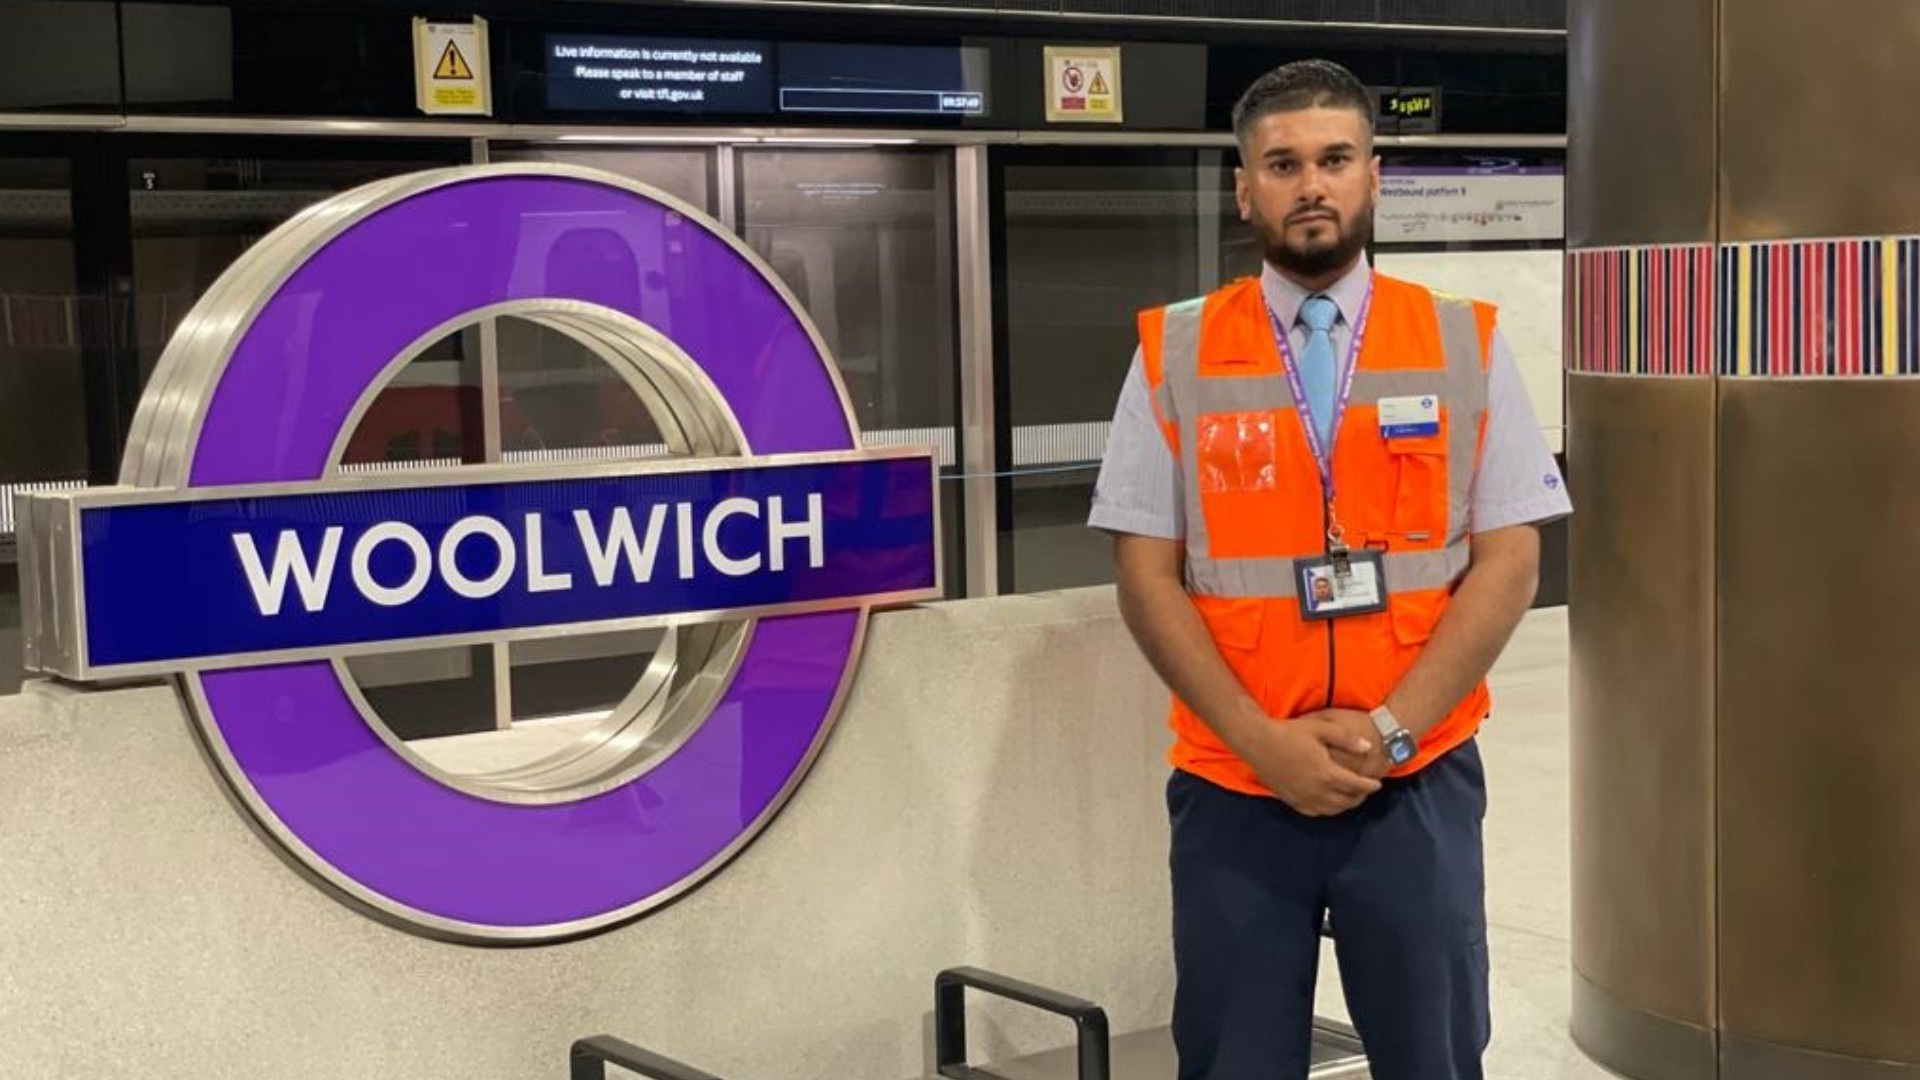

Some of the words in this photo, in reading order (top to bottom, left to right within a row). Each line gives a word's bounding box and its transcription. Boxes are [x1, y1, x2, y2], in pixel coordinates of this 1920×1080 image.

[555, 45, 577, 57] Live
[579, 46, 640, 59] information
[642, 48, 651, 59] is
[652, 50, 698, 63] currently
[700, 51, 717, 62] not
[719, 51, 763, 63] available
[575, 65, 609, 78] Please
[611, 68, 640, 80] speak
[643, 69, 655, 79] to
[664, 70, 705, 81] member
[707, 70, 719, 80] of
[721, 70, 744, 81] staff
[620, 89, 632, 98] or
[634, 88, 655, 99] visit
[657, 88, 704, 101] tfl.gov.uk
[1381, 186, 1424, 197] Westbound
[1426, 186, 1458, 198] platform
[232, 492, 824, 616] WOOLWICH
